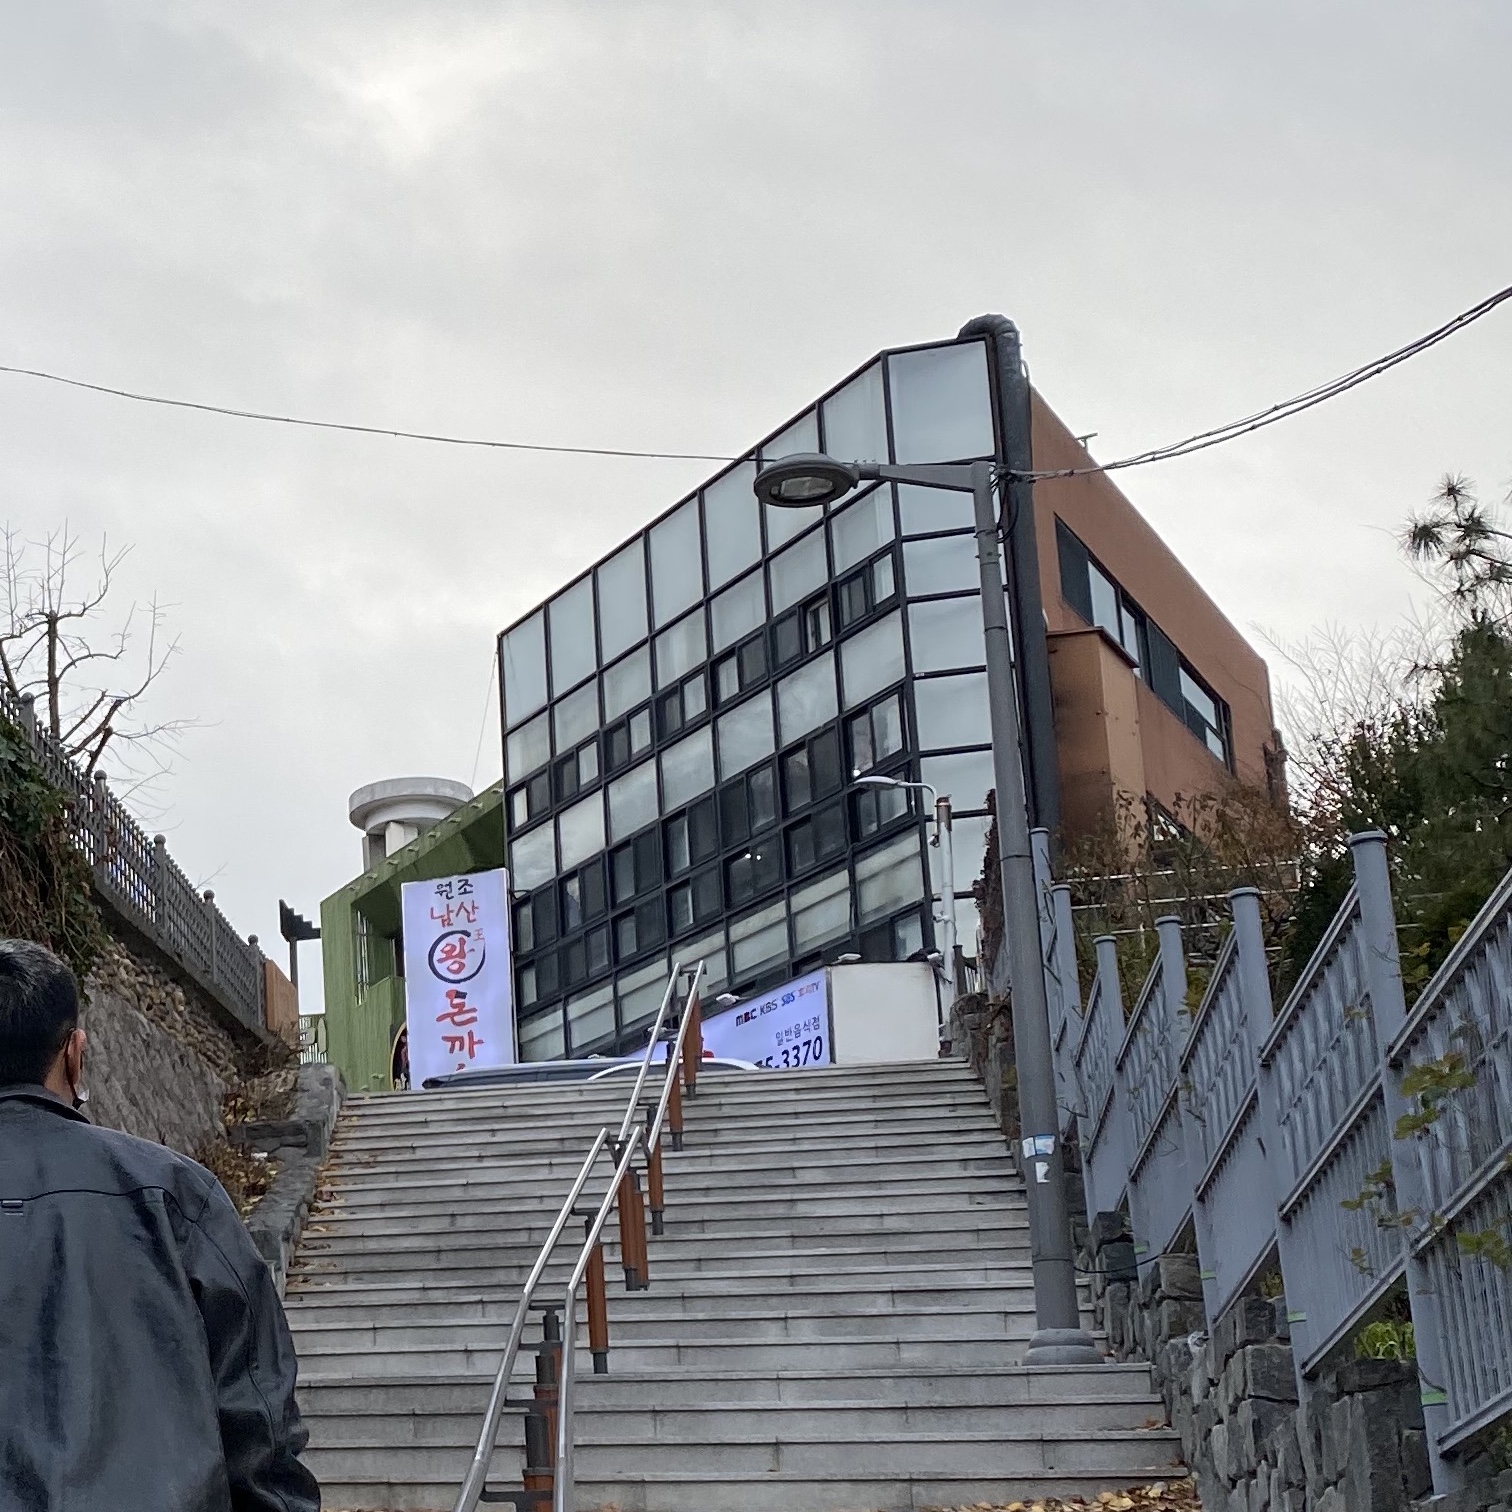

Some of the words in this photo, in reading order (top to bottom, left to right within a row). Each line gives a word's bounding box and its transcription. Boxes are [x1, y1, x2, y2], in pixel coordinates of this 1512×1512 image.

[434, 879, 473, 900] 원조
[430, 900, 479, 928] 남산
[759, 999, 778, 1016] KBS
[775, 1015, 820, 1047] 일반음식점
